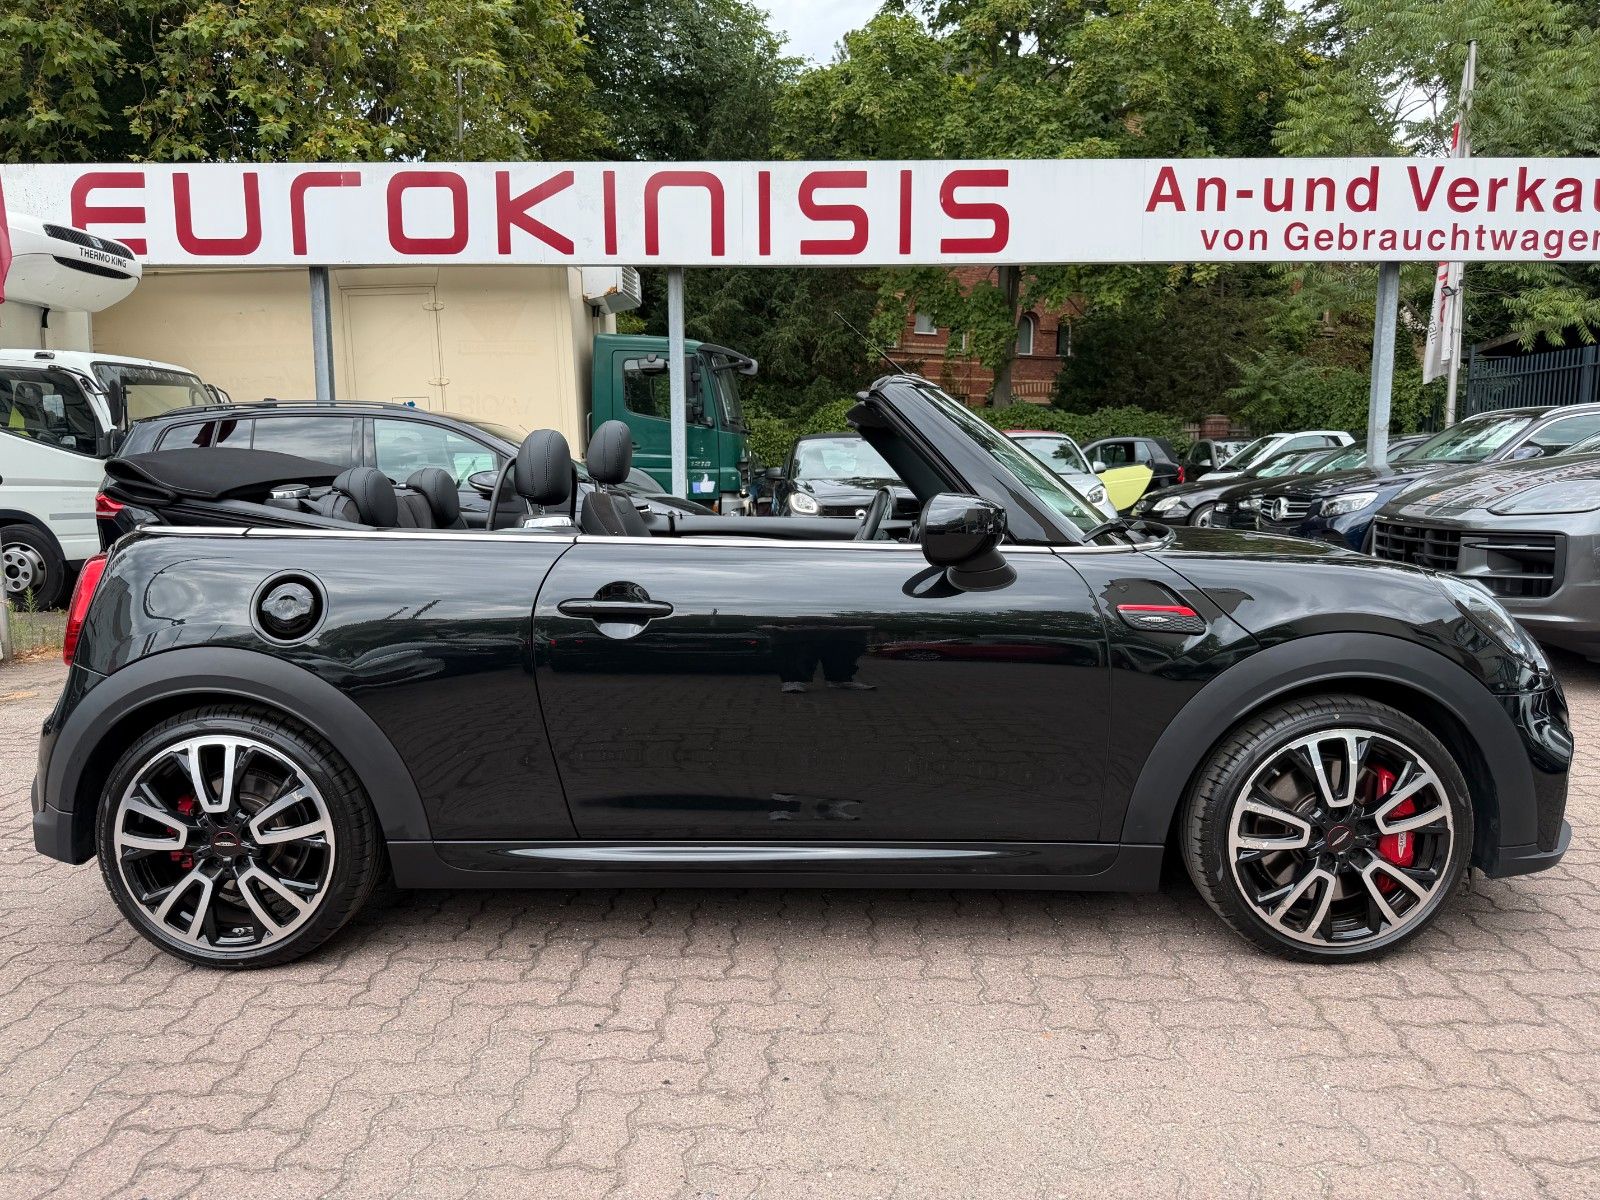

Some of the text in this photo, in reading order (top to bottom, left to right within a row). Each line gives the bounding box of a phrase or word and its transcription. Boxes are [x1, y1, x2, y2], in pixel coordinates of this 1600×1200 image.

[1145, 166, 1600, 213] An-und Verka
[1200, 229, 1268, 251] von
[79, 247, 127, 268] THERMO KING
